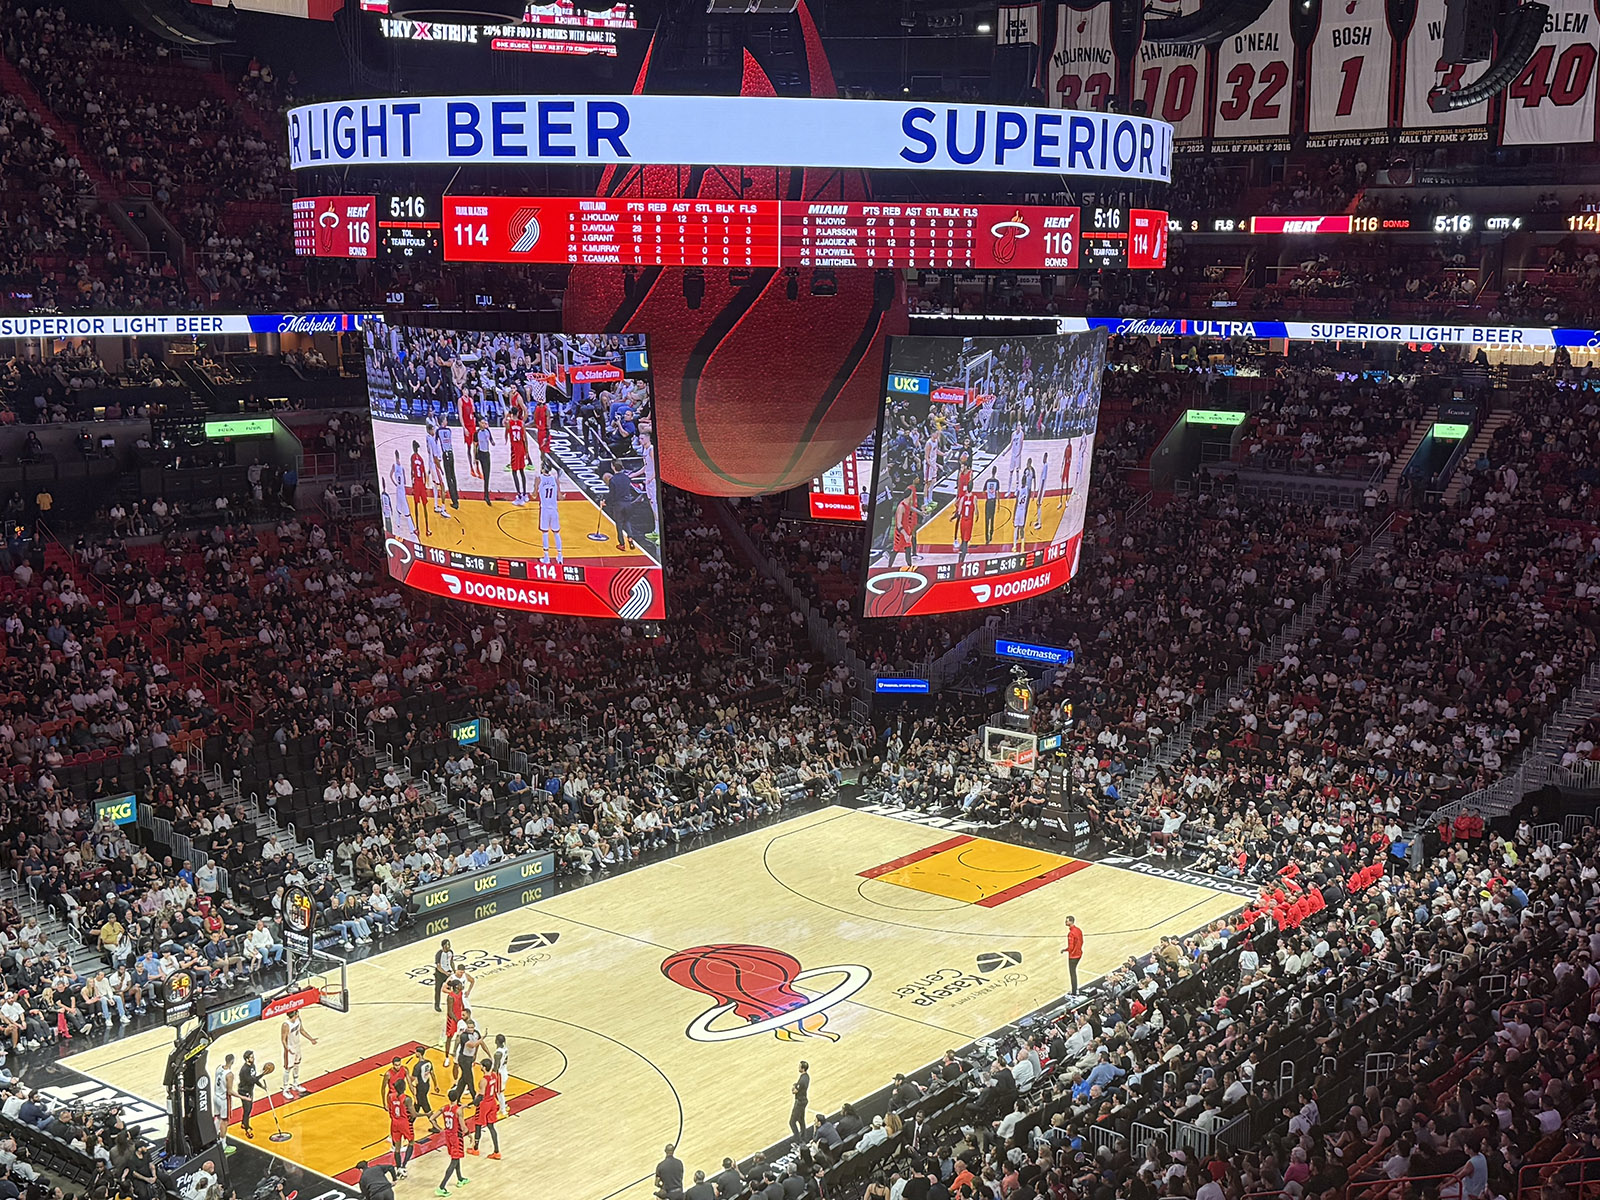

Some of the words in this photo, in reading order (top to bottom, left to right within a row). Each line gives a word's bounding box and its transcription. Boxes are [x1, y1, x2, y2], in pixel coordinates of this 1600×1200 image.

[502, 26, 516, 36] OFF
[1542, 13, 1589, 34] SLEM
[1234, 32, 1280, 54] O'NEAL
[1332, 26, 1372, 48] BOSH
[1054, 48, 1112, 68] MOURNING
[1140, 44, 1202, 63] HARDAWAY
[1510, 42, 1598, 108] 40
[1141, 64, 1198, 122] 10
[1220, 60, 1290, 121] 32
[1335, 56, 1364, 117] 1
[308, 103, 420, 160] LIGHT
[447, 101, 632, 157] BEER
[1399, 134, 1420, 143] HALL
[1422, 134, 1433, 143] OF
[1434, 133, 1457, 142] FAME
[1467, 132, 1488, 141] 2023
[899, 107, 1154, 174] SUPERIOR
[1306, 139, 1326, 148] HALL
[1328, 139, 1338, 147] OF
[1339, 138, 1361, 146] FAME
[1370, 136, 1389, 144] 2021
[347, 203, 370, 218] HEAT
[390, 196, 424, 217] 5:16
[627, 202, 644, 211] PTS
[648, 203, 667, 212] REB
[672, 204, 690, 212] AST
[695, 204, 712, 212] STL
[716, 204, 734, 213] BLK
[740, 204, 757, 213] FLS
[808, 204, 848, 215] MIAMI
[863, 207, 880, 215] PTS
[883, 207, 901, 215] REB
[906, 207, 922, 216] AST
[926, 208, 941, 216] STL
[944, 208, 960, 216] BLK
[963, 208, 978, 216] FLS
[1044, 214, 1074, 228] HEAT
[1094, 208, 1120, 228] 5:16
[1191, 220, 1198, 231] 3
[1215, 220, 1233, 231] FLS
[1238, 220, 1245, 231] 4
[1283, 217, 1322, 232] HEAT
[1354, 217, 1378, 231] 116
[1383, 220, 1409, 228] BONUS
[1435, 216, 1471, 232] 5:16
[1487, 218, 1510, 230] QTR
[1512, 218, 1521, 230] 4
[1568, 216, 1594, 230] 114
[347, 222, 370, 244] 116
[454, 224, 489, 246] 114
[348, 247, 367, 256] BONUS
[404, 248, 413, 256] CC
[1043, 232, 1072, 254] 116
[1134, 234, 1148, 254] 114
[1045, 258, 1068, 267] BONUS
[2, 318, 105, 335] SUPERIOR
[112, 318, 168, 333] LIGHT
[176, 317, 223, 332] BEER
[278, 315, 336, 333] Michelob
[1116, 318, 1176, 335] Michelob
[1193, 320, 1256, 337] ULTRA
[1310, 324, 1401, 340] SUPERIOR
[1409, 326, 1465, 341] LIGHT
[1472, 328, 1523, 343] BEER
[894, 376, 919, 391] UKG
[550, 438, 610, 494] Robinhood
[545, 488, 553, 499] 11
[430, 548, 446, 563] 116
[465, 557, 484, 570] 5:16
[489, 562, 494, 570] 7
[534, 565, 556, 579] 114
[961, 562, 979, 577] 116
[1000, 558, 1016, 571] 5:16
[1020, 558, 1025, 566] 7
[1048, 547, 1058, 560] 114
[465, 581, 549, 605] DOORDASH
[994, 572, 1051, 598] DOORDASH
[1007, 645, 1061, 661] ticketmaster
[521, 862, 542, 878] UKG
[474, 876, 497, 892] UKG
[425, 890, 449, 907] UKG
[892, 968, 962, 998] Center
[911, 975, 990, 1006] Kaseya
[220, 1004, 250, 1024] UKG
[199, 1090, 208, 1112] AT&T
